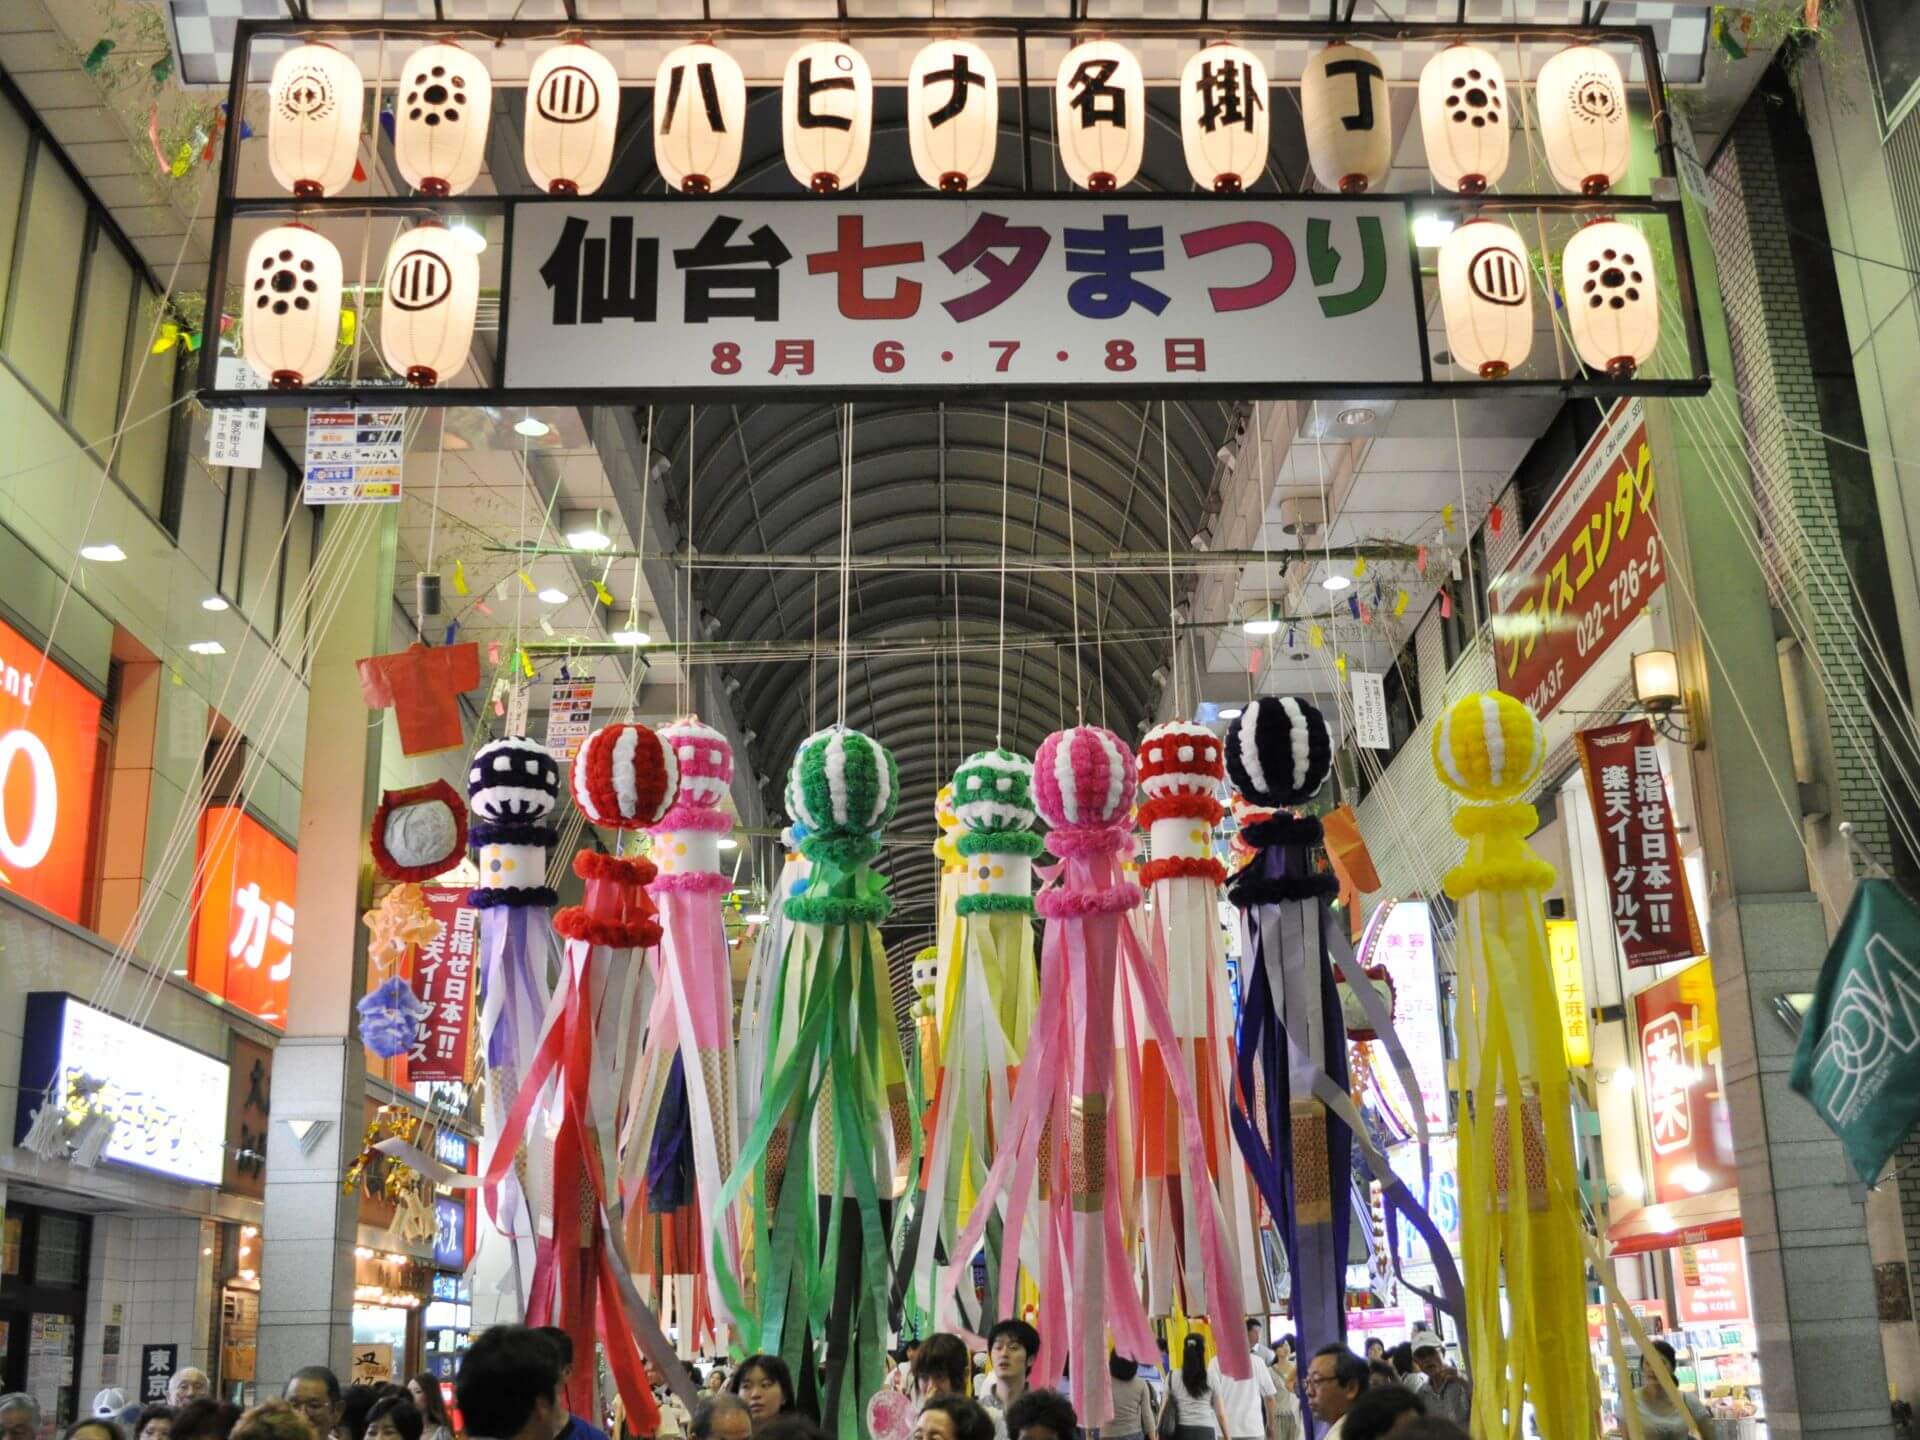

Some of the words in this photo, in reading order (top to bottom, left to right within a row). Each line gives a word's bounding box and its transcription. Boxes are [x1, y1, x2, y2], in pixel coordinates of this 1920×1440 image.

[539, 211, 1388, 325] 仙台七夕まつり
[1602, 765, 1643, 943] 楽天イーグルス
[1560, 944, 1585, 1038] リーチ麻雀
[147, 1350, 171, 1405] 東京
